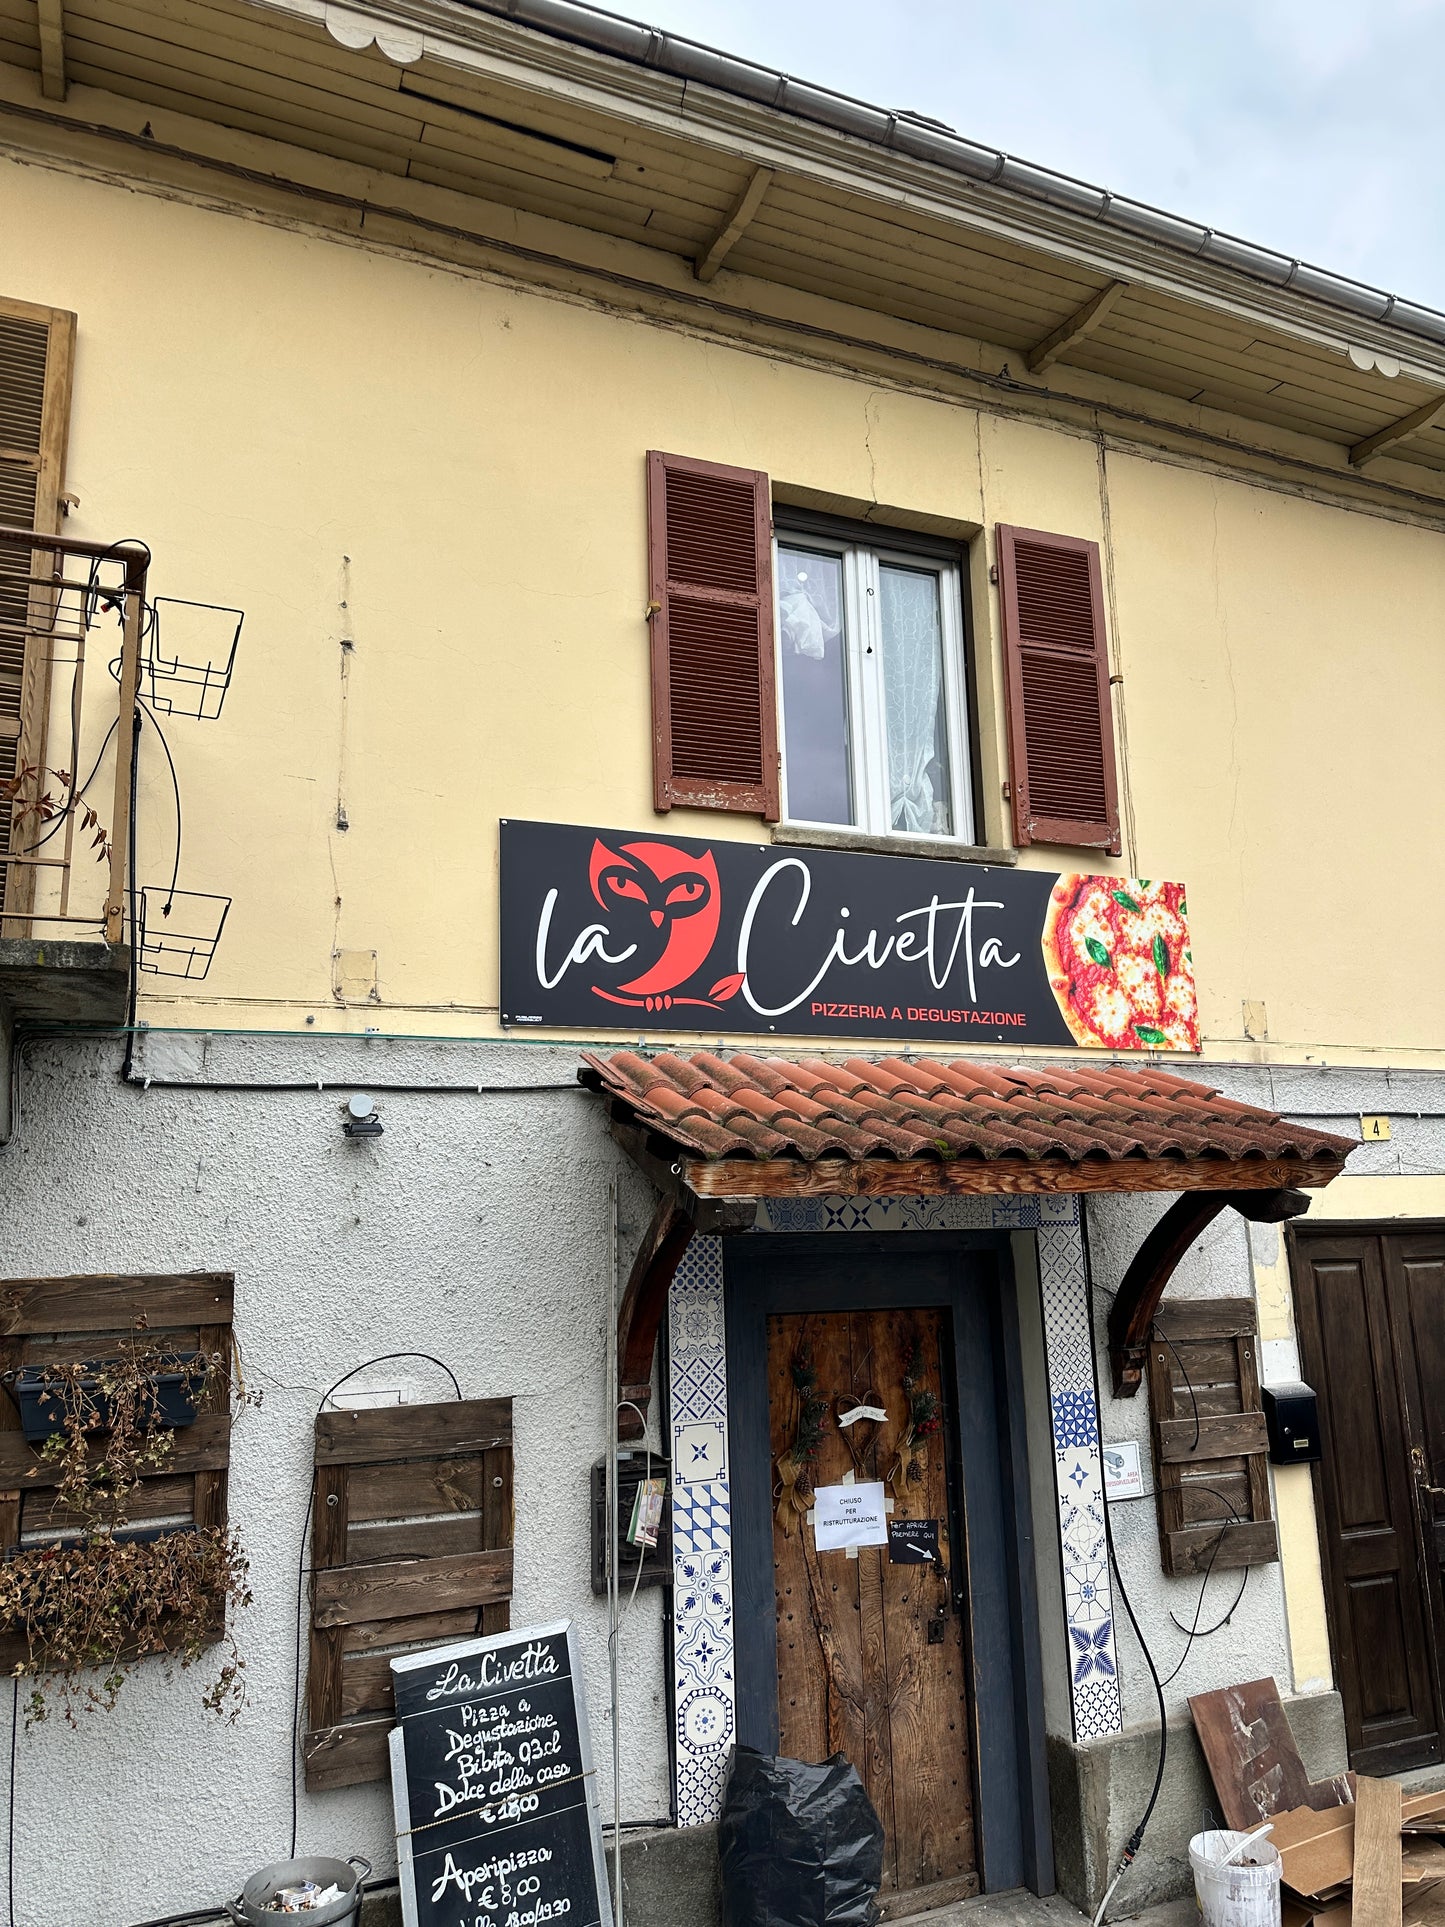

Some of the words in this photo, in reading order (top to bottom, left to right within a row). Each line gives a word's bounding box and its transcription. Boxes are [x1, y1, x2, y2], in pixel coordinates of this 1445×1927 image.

[737, 857, 1021, 1016] Civetta
[811, 1002, 886, 1019] PIZZERIA
[891, 1006, 902, 1020] A
[907, 1007, 1027, 1026] DEGUSTAZIONE
[1373, 1119, 1380, 1137] 4
[839, 1497, 862, 1505] CHIUSO
[823, 1515, 878, 1527] RISTRUTTURAZIONE
[425, 1662, 476, 1700] La
[476, 1641, 560, 1690] Civetta
[460, 1704, 511, 1727] Pizza
[518, 1698, 531, 1712] a
[444, 1713, 558, 1761] Degustazione
[457, 1741, 515, 1780] Bibita
[434, 1777, 486, 1817] Dolce
[489, 1767, 534, 1795] della
[536, 1763, 571, 1783] casa
[479, 1802, 497, 1823] €
[431, 1847, 553, 1902] Aperipizza
[477, 1885, 499, 1910] €
[501, 1875, 541, 1908] 8,00
